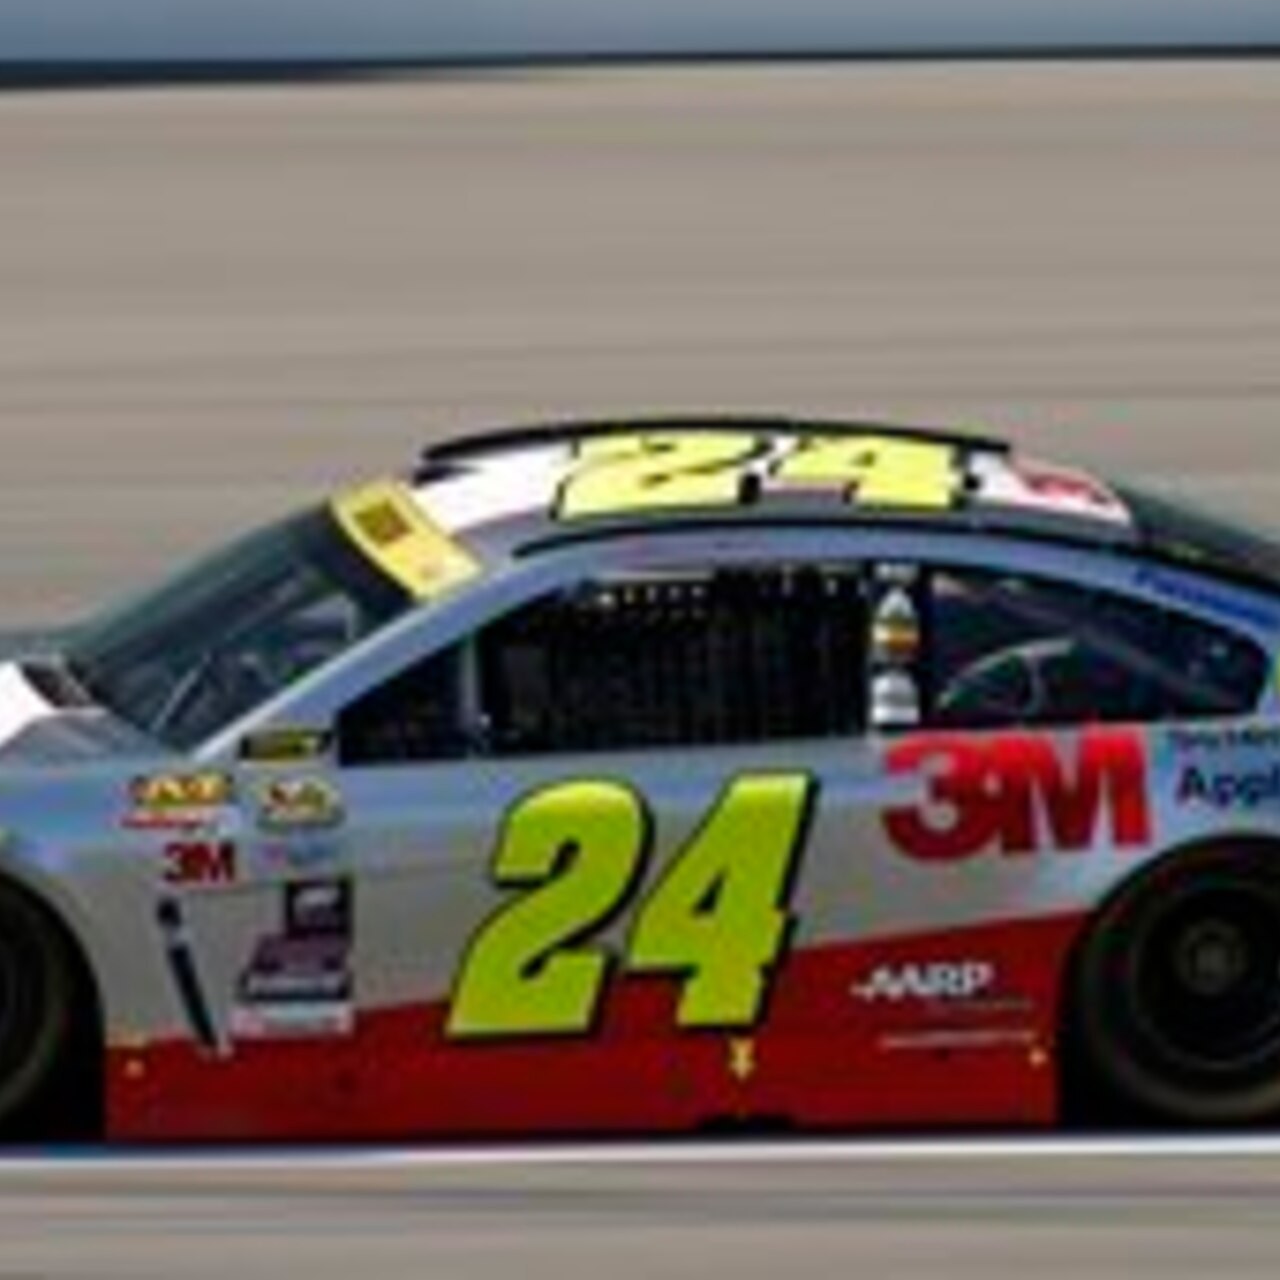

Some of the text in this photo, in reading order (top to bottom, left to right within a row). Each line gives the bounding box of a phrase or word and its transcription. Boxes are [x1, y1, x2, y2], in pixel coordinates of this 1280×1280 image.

[550, 432, 978, 520] 24
[878, 723, 1152, 862] 3M
[163, 841, 236, 884] 3M
[442, 770, 816, 1042] 24
[850, 960, 996, 1003] AARP
